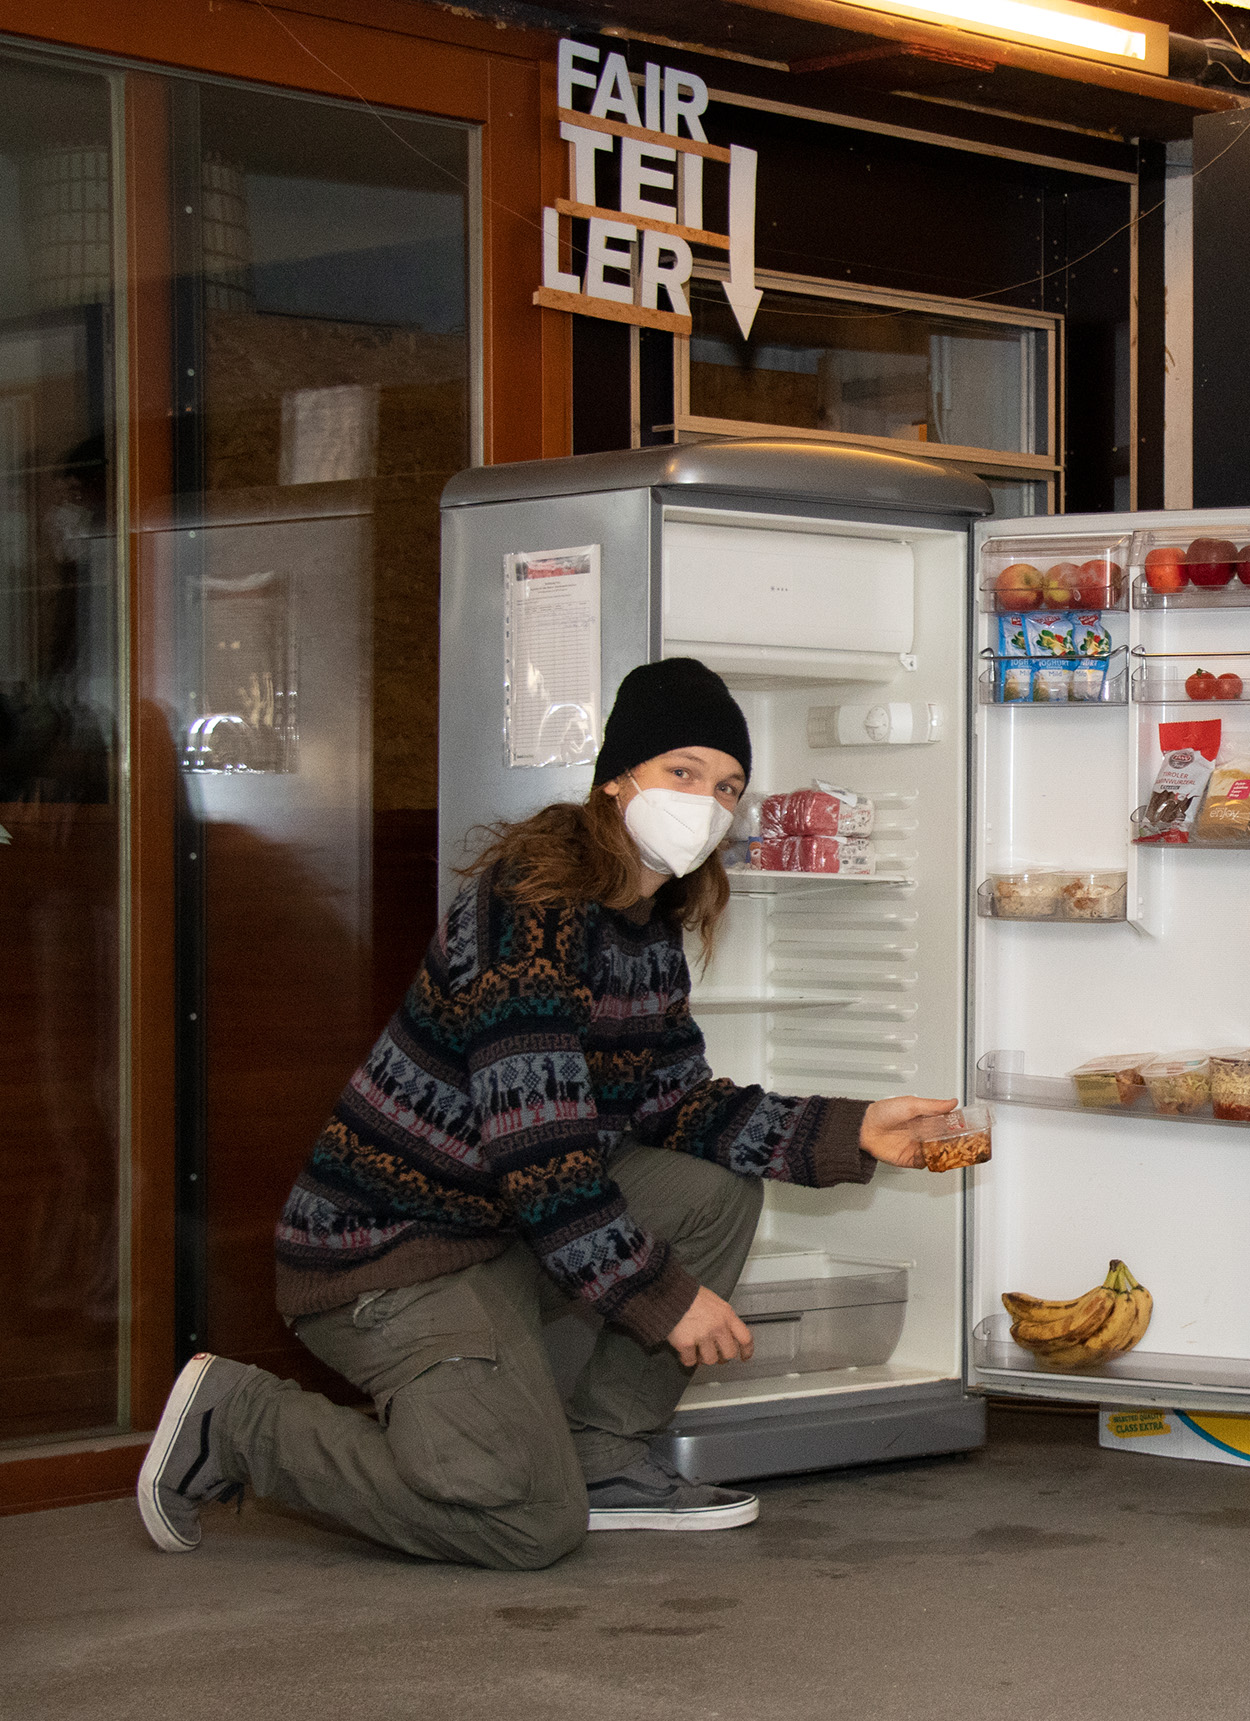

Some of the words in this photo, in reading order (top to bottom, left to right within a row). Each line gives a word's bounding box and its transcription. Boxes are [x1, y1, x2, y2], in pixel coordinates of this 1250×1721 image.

[556, 38, 709, 144] FAIR
[559, 121, 705, 231] TEI
[542, 205, 693, 317] LER
[1116, 1423, 1138, 1433] CLASS
[1139, 1421, 1164, 1431] EXTRA
